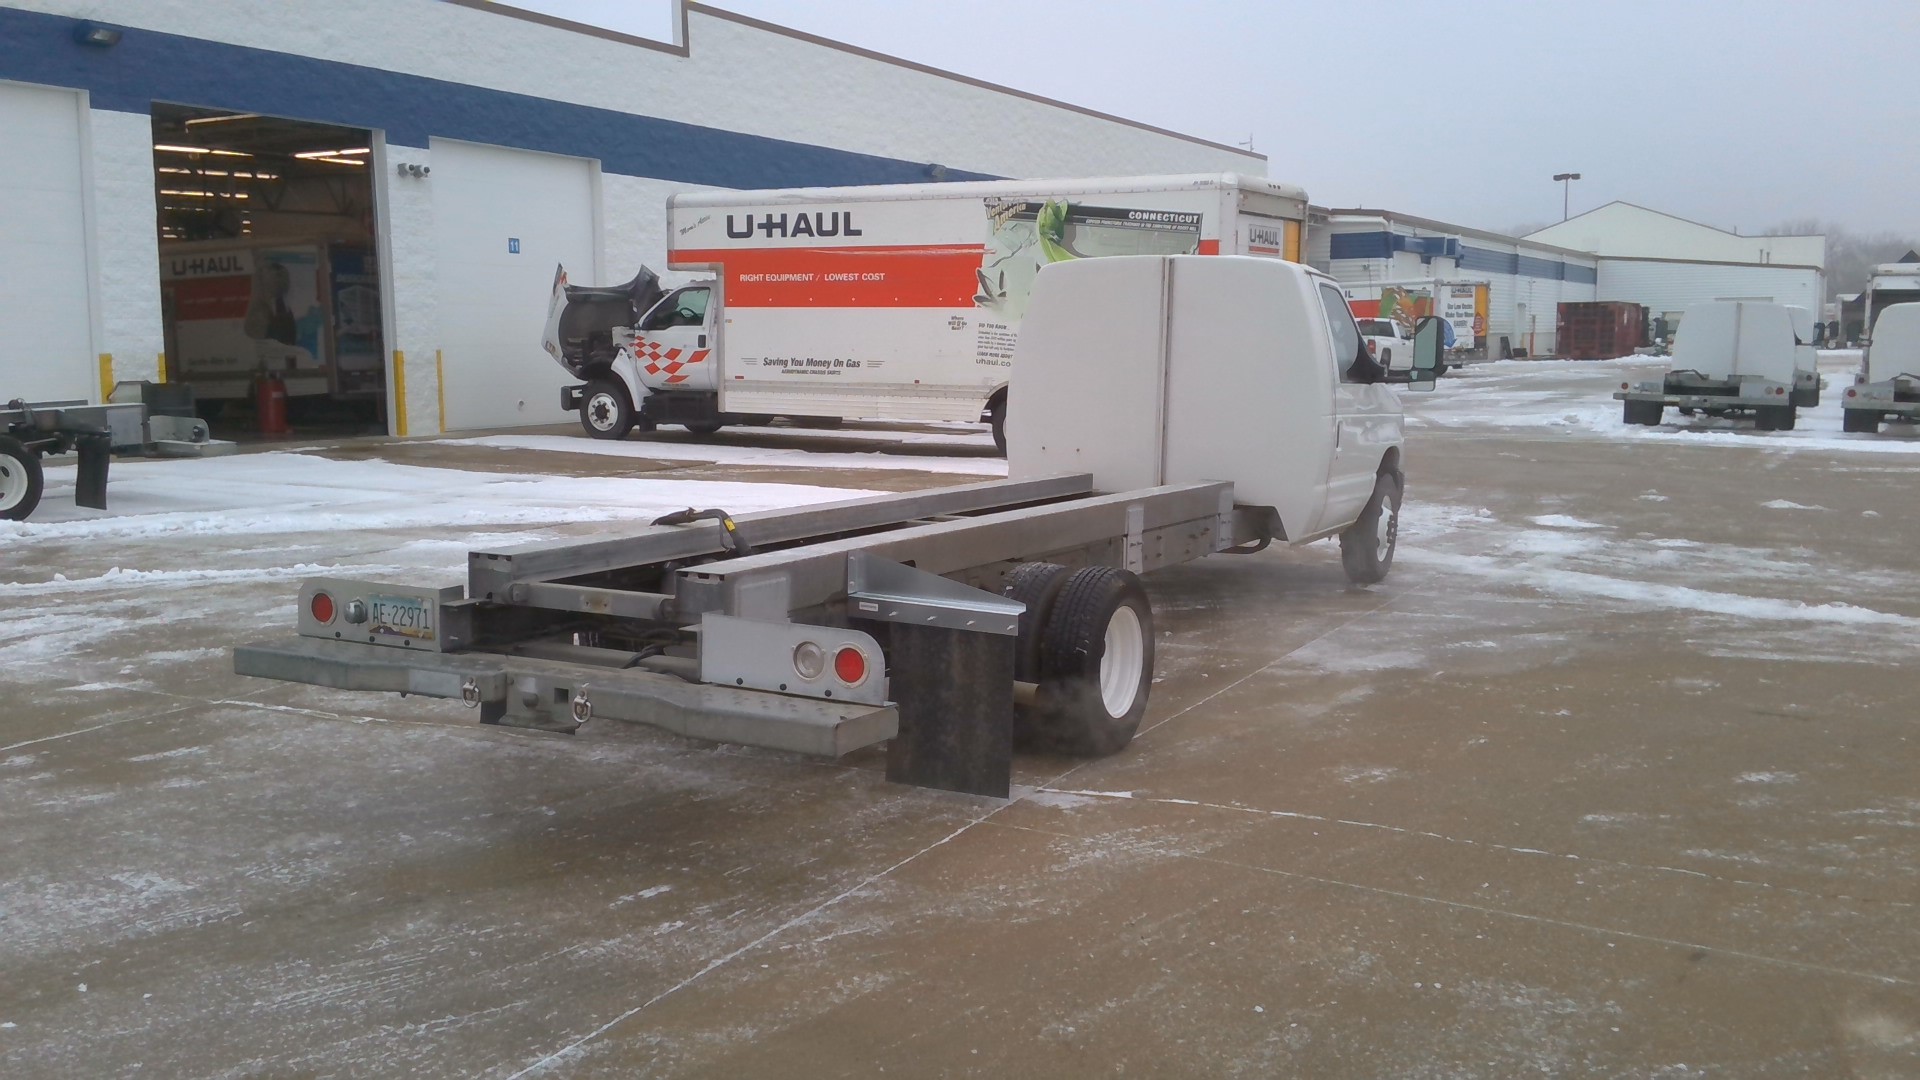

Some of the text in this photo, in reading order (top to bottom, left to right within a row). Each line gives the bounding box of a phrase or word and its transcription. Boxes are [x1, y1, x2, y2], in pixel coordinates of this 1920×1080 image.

[1128, 210, 1199, 224] CONNECTICUT
[726, 211, 863, 239] U-HAUL
[1249, 227, 1280, 246] U-HAUL
[171, 255, 245, 276] U-HAUL
[739, 273, 764, 282] RIGHT
[765, 273, 815, 282] EQUIPMENT
[824, 273, 860, 282] LOWEST
[861, 272, 886, 281] COST
[762, 356, 861, 369] Saving You Money On Gas
[975, 358, 1012, 367] uhaul.co
